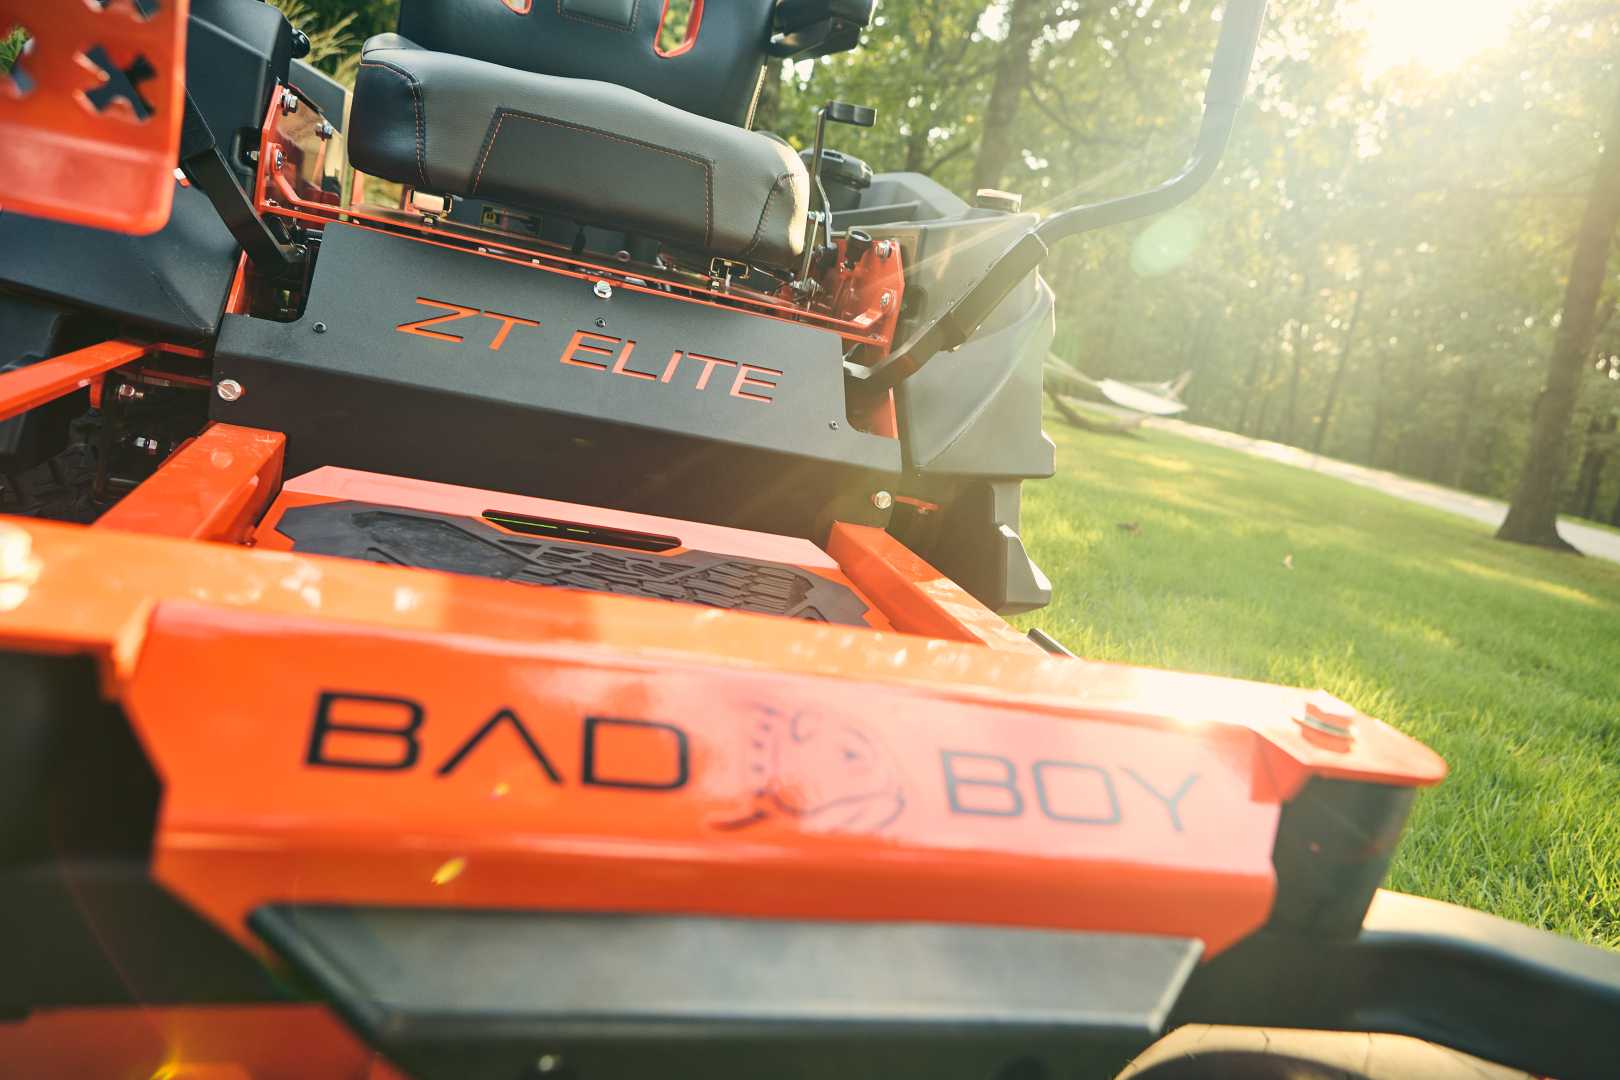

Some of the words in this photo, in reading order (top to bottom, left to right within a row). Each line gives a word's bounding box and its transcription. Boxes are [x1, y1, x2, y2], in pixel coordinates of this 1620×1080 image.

[396, 297, 541, 351] ZT
[559, 329, 783, 404] ELITE
[305, 689, 691, 791] BAD
[938, 749, 1200, 832] BOY
